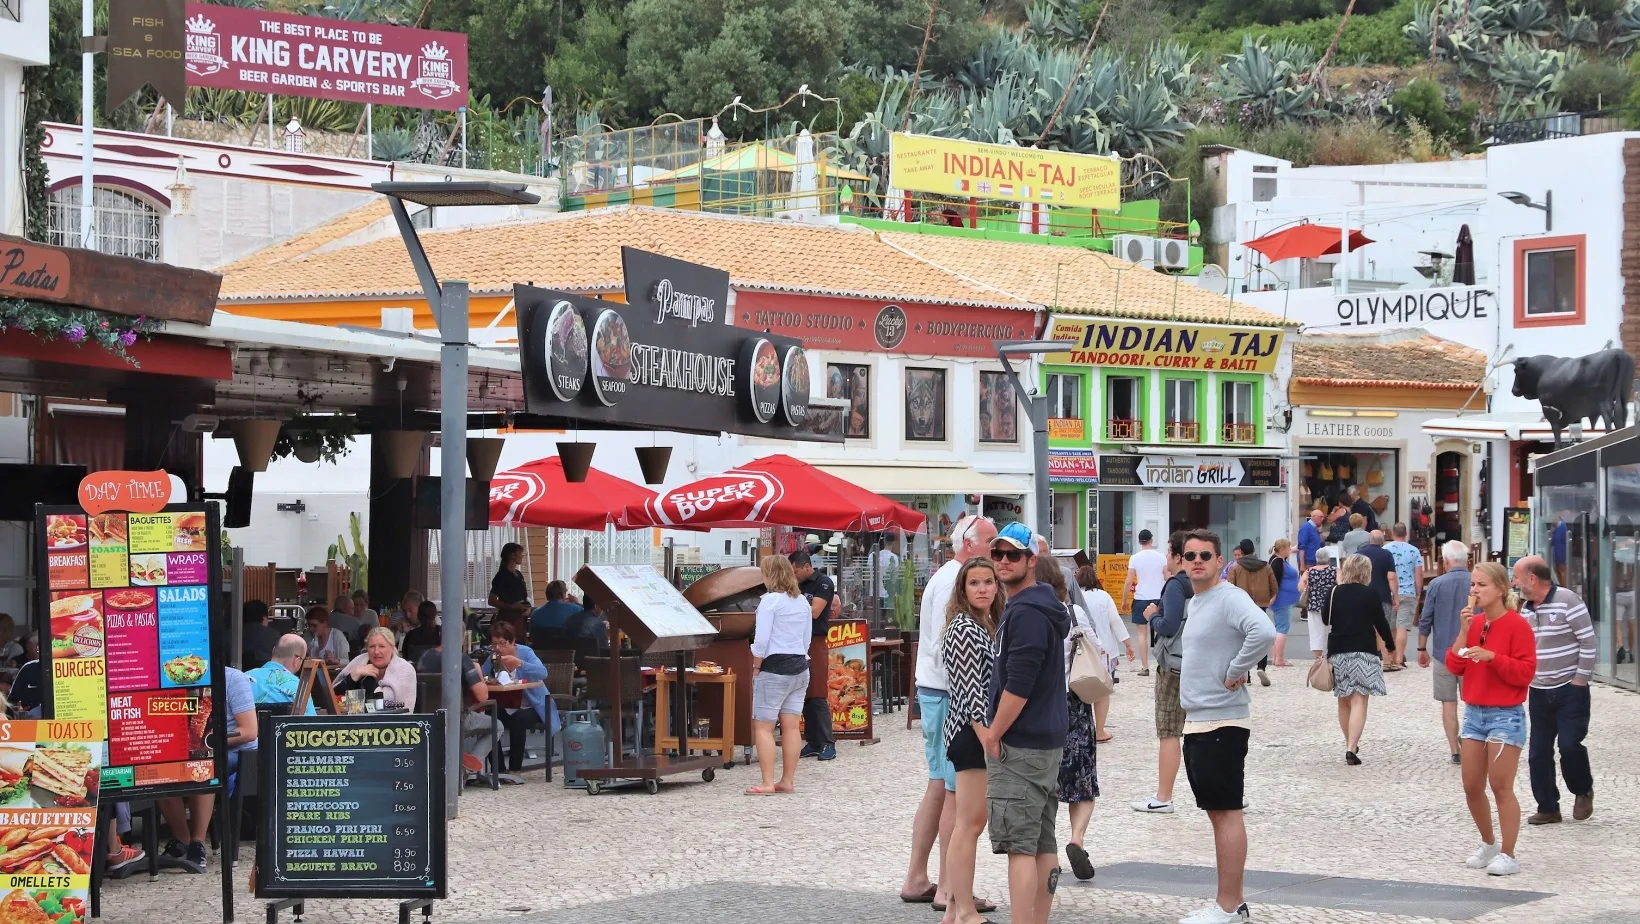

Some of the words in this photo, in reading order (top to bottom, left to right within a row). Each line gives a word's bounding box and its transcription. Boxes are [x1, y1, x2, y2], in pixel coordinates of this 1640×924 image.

[132, 17, 164, 27] FISH
[260, 20, 281, 33] THE
[284, 23, 311, 37] BEST
[315, 27, 349, 41] PLACE
[352, 31, 366, 43] TO
[369, 33, 382, 45] BE
[187, 34, 216, 47] KING
[113, 47, 142, 57] SEA
[147, 49, 182, 59] FOOD
[187, 45, 216, 54] CARVERY
[231, 35, 290, 67] KING
[299, 43, 413, 79] CARVERY
[422, 60, 449, 73] KING
[240, 69, 268, 83] BEER
[272, 73, 318, 88] GARDEN
[321, 79, 332, 90] &
[336, 80, 380, 94] SPORTS
[383, 84, 405, 97] BAR
[897, 148, 937, 159] RESTAURANTE
[1011, 151, 1037, 159] WELCOME
[944, 152, 1024, 182] INDIAN
[1039, 163, 1076, 187] TAJ
[0, 248, 59, 291] Pastas
[657, 279, 715, 327] Pampas
[1337, 289, 1488, 325] OLYMPIQUE
[754, 309, 802, 328] TATTOO
[806, 313, 853, 331] STUDIO
[878, 314, 904, 329] Lucky
[885, 325, 895, 337] 13
[927, 320, 1014, 339] BODYPIERCING
[1056, 324, 1082, 333] Comida
[1083, 324, 1199, 354] INDIAN
[1229, 333, 1279, 357] TAJ
[629, 342, 735, 396] STEAKHOUSE
[1154, 355, 1200, 369] CURRY
[1204, 357, 1216, 369] &
[1220, 358, 1258, 371] BALTI
[558, 375, 580, 391] STEAKS
[602, 380, 626, 393] SEAFOOD
[760, 401, 776, 414] PIZZAS
[790, 404, 806, 416] PASTAS
[1054, 420, 1073, 428] INDIAN
[1074, 421, 1083, 429] TAJ
[1307, 423, 1361, 436] LEATHER
[1364, 427, 1393, 437] GOODS
[1049, 460, 1075, 469] NDIAN
[1079, 461, 1095, 469] TAJ
[1146, 457, 1194, 484] indian
[1197, 462, 1236, 484] GRILL
[85, 482, 121, 500] DAY
[126, 479, 165, 499] TIME
[669, 481, 756, 503] SUPER
[676, 488, 756, 520] BOCK
[130, 516, 172, 525] BAGUETTES
[174, 536, 193, 545] FRESH
[49, 555, 86, 567] BREAKFAST
[168, 554, 205, 565] WRAPS
[160, 587, 207, 602] SALADS
[107, 614, 125, 628] PIZZAS
[126, 613, 133, 627] &
[135, 612, 156, 627] PASTAS
[827, 622, 862, 642] CIAL
[74, 636, 101, 647] DELICIOUS
[55, 660, 104, 678] BURGERS
[111, 696, 132, 708] MEAT
[152, 701, 195, 711] SPECIAL
[111, 709, 122, 720] OR
[124, 708, 141, 719] FISH
[47, 722, 93, 739] TOASTS
[286, 727, 421, 748] SUGGESTIONS
[286, 756, 355, 765] CALAMARES
[103, 768, 132, 776] VEGETARIAN
[286, 765, 347, 774] CALAMARI
[286, 779, 350, 787] SARDINHAS
[395, 781, 414, 790] 7.50
[286, 788, 341, 797] SARDINES
[286, 802, 360, 810] ENTRECOSTO
[394, 804, 416, 812] 10.50
[0, 812, 92, 825] BAGUETTES
[286, 812, 321, 820] SPARE
[325, 812, 351, 820] RIBS
[286, 825, 331, 834] FRANGO
[335, 825, 358, 833] PIRI
[360, 825, 382, 833] PIRI
[395, 827, 415, 836] 6.50
[286, 835, 336, 843] CHICKEN
[341, 834, 363, 843] PIRI
[365, 834, 388, 843] PIRI
[286, 849, 318, 857] PIZZA
[323, 849, 365, 857] HAWAII
[286, 863, 336, 871] BAGUETE
[341, 862, 378, 871] BRAVO
[11, 876, 71, 888] OMELLETS
